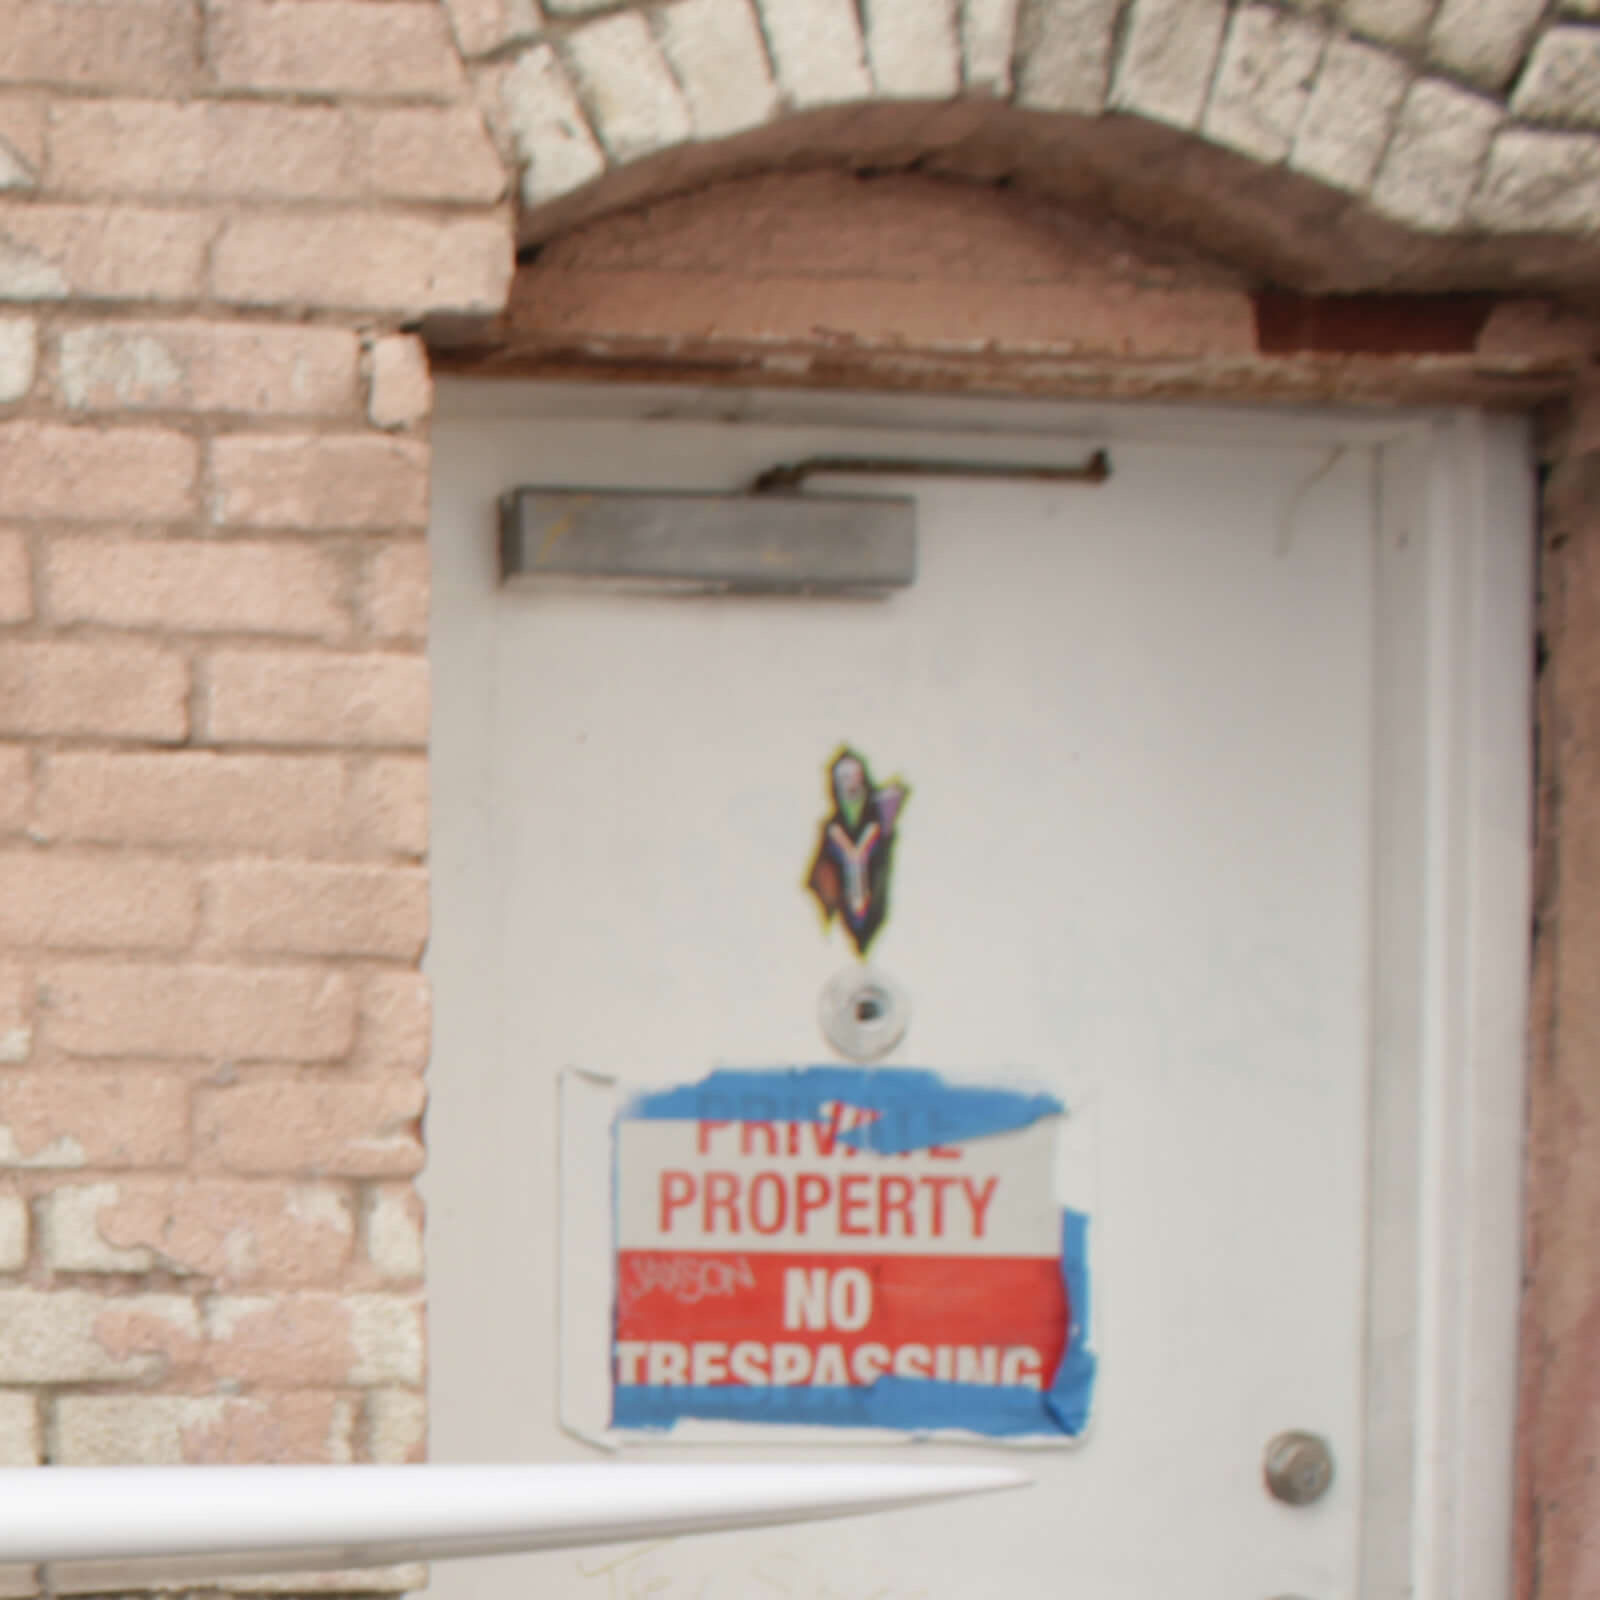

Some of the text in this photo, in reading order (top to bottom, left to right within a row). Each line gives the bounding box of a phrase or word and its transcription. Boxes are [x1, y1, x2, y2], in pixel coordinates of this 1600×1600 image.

[697, 1098, 963, 1157] PRIV
[658, 1171, 999, 1239] PROPERTY
[783, 1266, 872, 1332] NO
